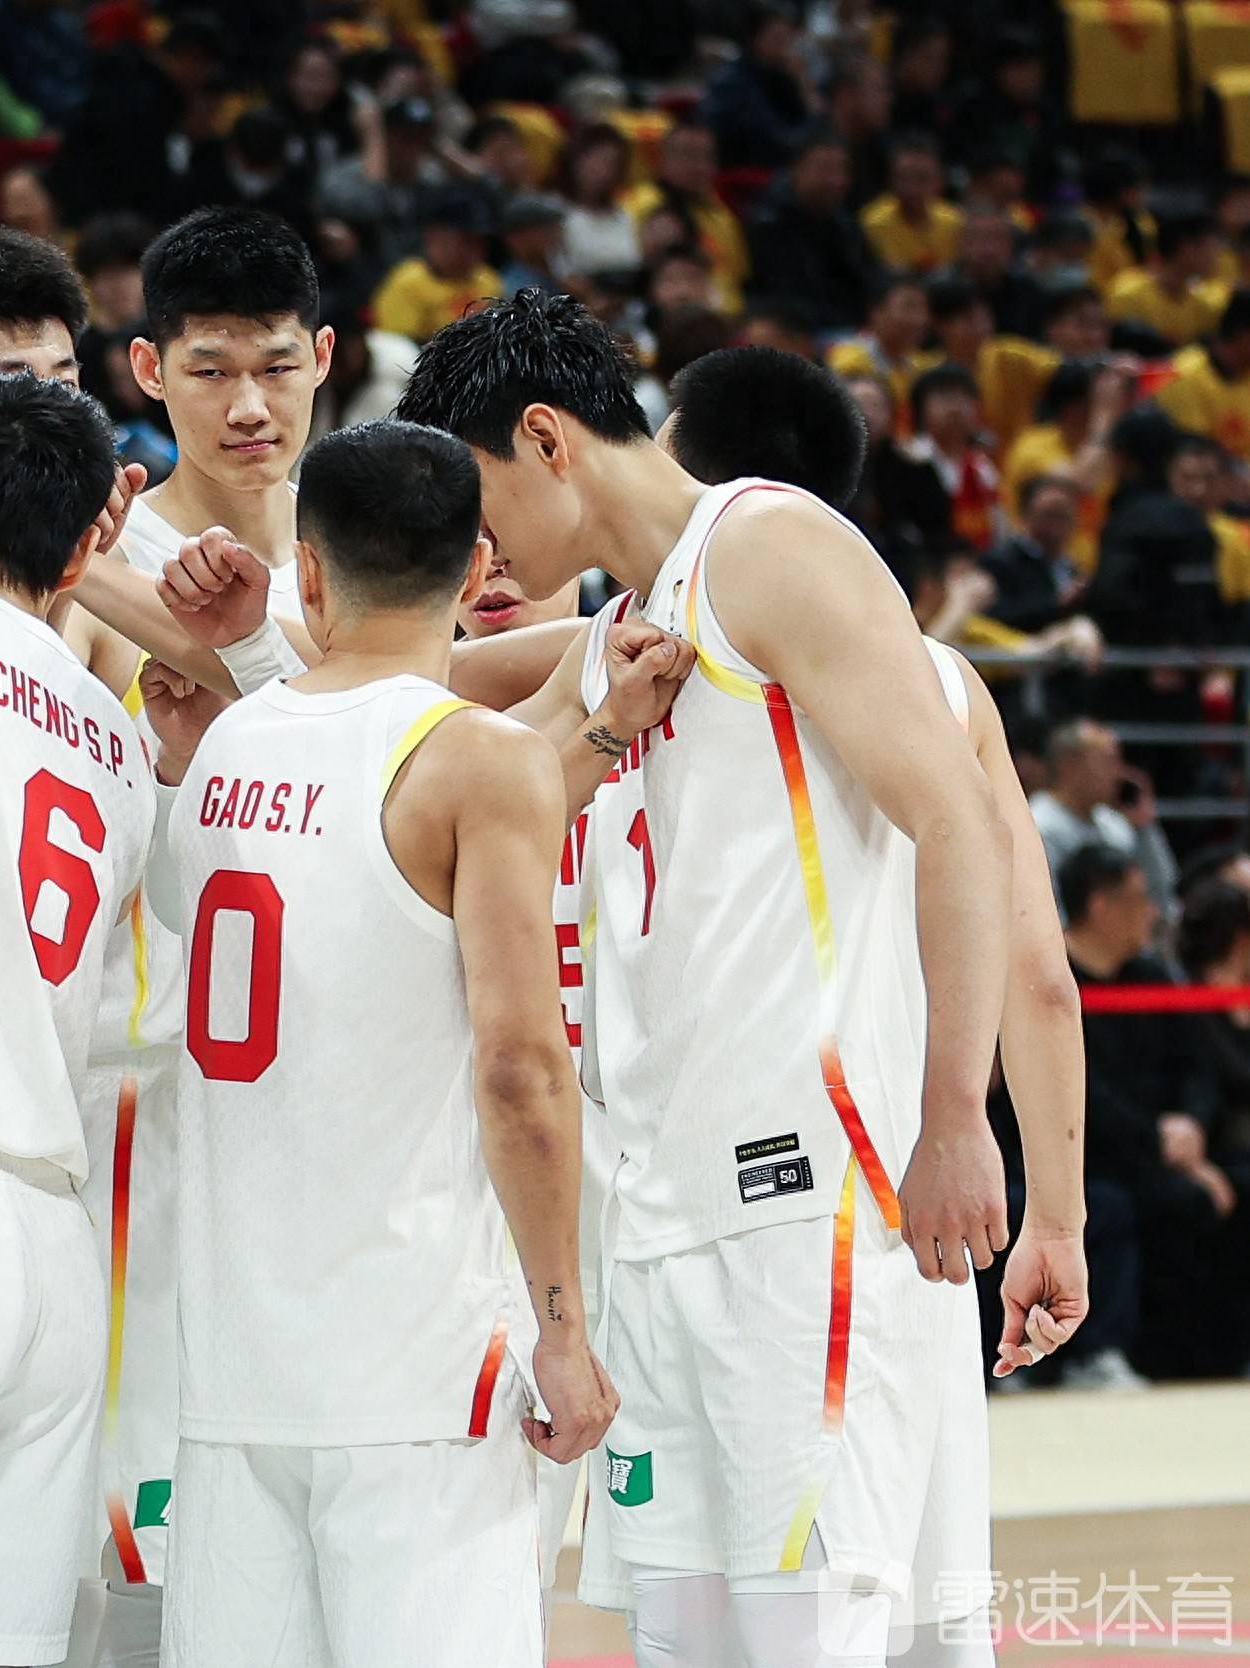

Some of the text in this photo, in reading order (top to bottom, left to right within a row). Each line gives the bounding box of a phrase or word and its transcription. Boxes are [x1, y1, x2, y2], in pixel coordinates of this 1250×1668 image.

[84, 718, 133, 789] S.P.
[200, 776, 325, 835] GAO S.Y.
[18, 768, 106, 987] 6
[187, 869, 284, 1083] 0
[779, 1169, 798, 1184] 50
[607, 1457, 633, 1494] 寶
